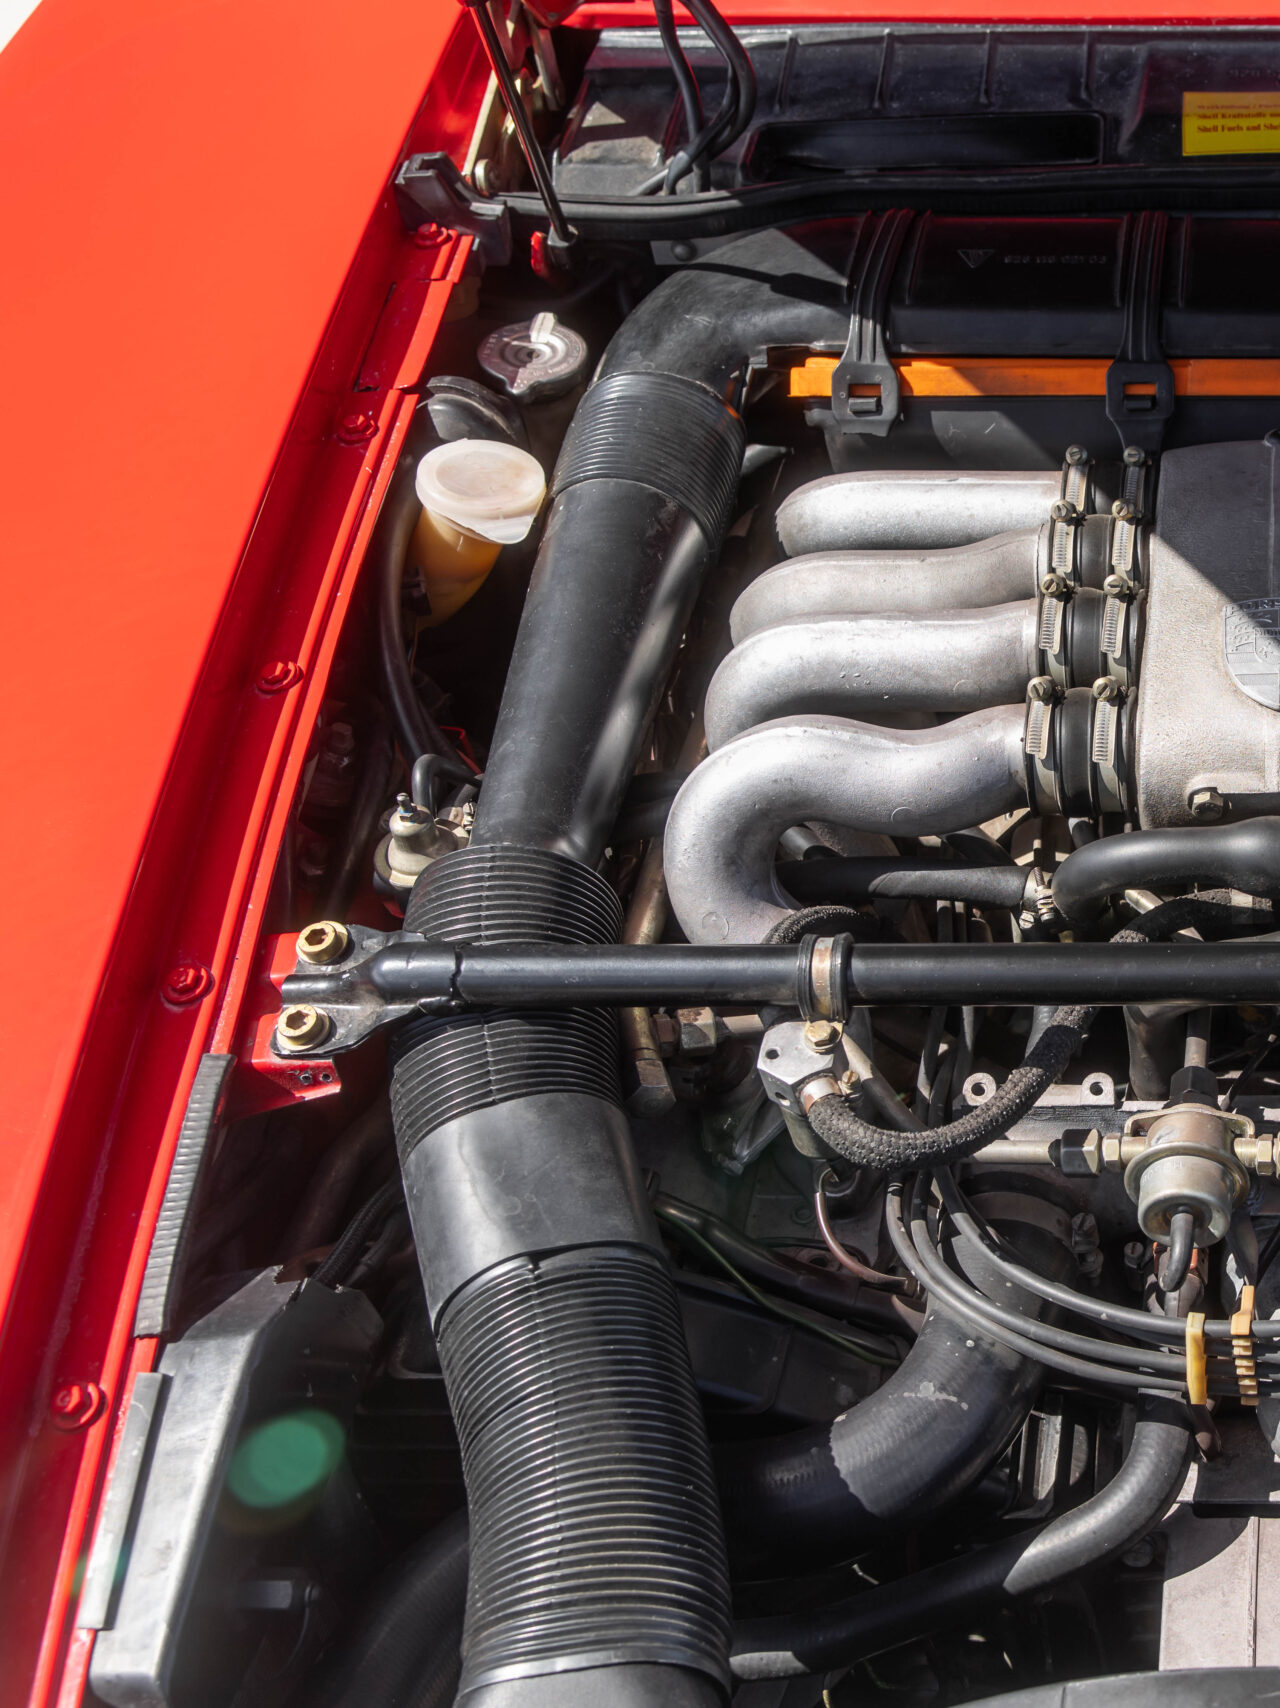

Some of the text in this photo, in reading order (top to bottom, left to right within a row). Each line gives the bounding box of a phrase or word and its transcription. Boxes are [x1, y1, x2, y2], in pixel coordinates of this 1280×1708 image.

[1197, 124, 1218, 132] Shell
[1221, 124, 1244, 132] Fuels
[1246, 123, 1261, 131] and
